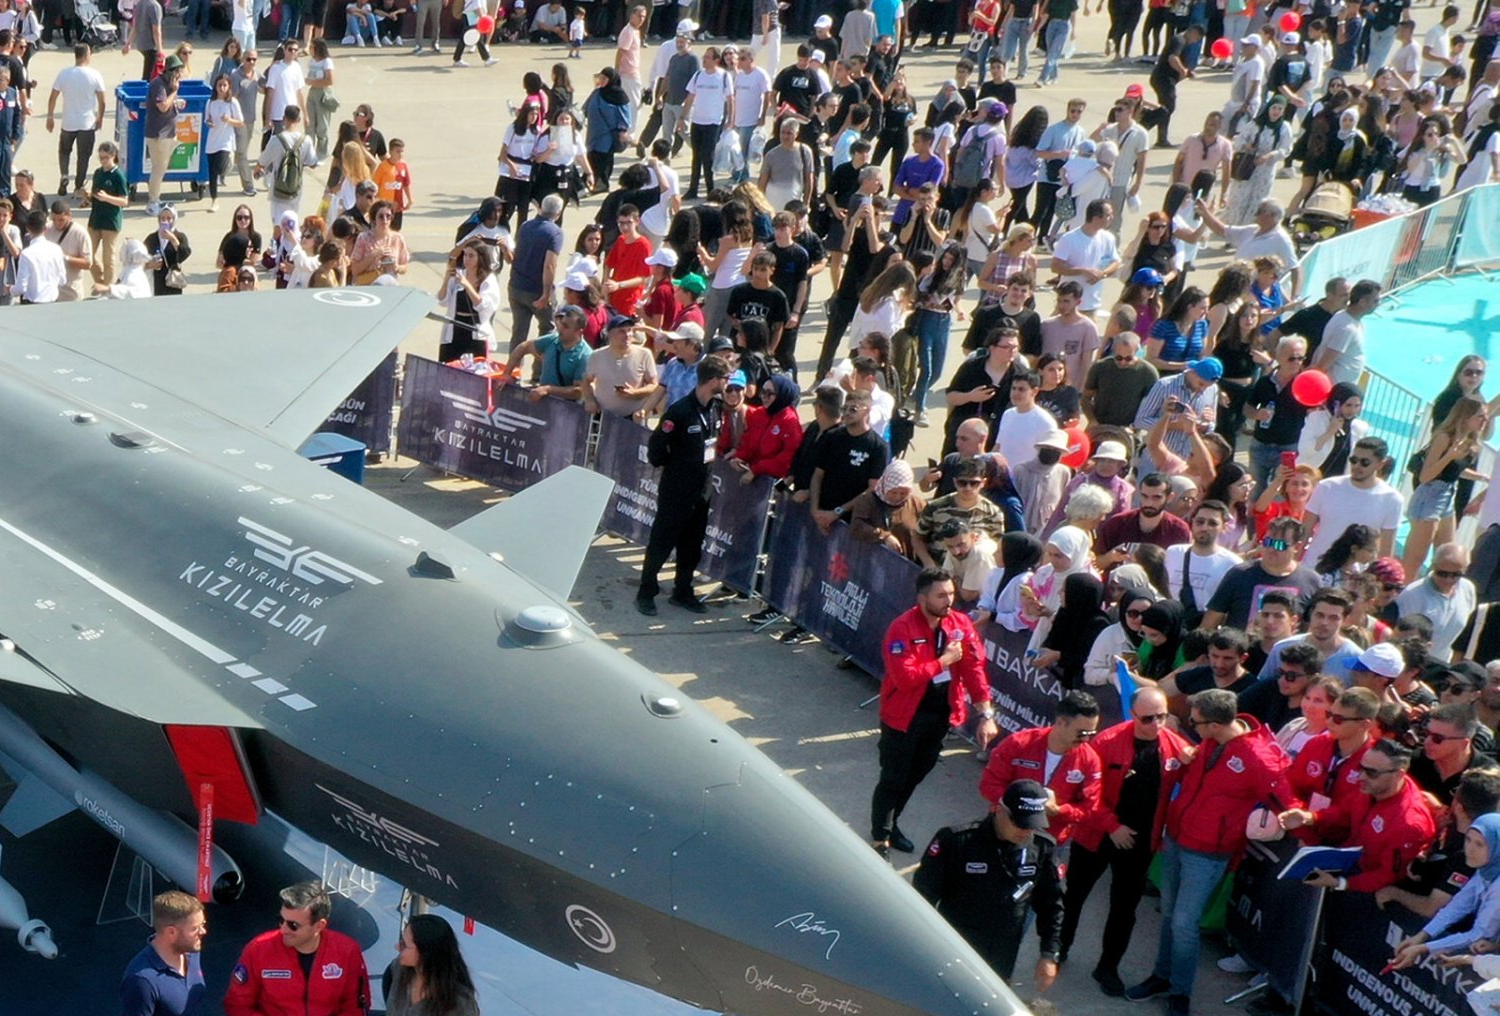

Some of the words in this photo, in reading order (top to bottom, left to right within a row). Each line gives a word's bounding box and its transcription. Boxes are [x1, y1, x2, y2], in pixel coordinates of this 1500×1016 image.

[433, 428, 543, 474] KIZILELMA
[454, 420, 526, 448] BAYRAKTAR
[179, 561, 328, 647] KIZILELMA
[224, 556, 324, 609] BAYRAKTAR
[995, 649, 1066, 701] BAYKA
[83, 796, 126, 838] roketsan
[331, 812, 460, 890] KIZILELMA
